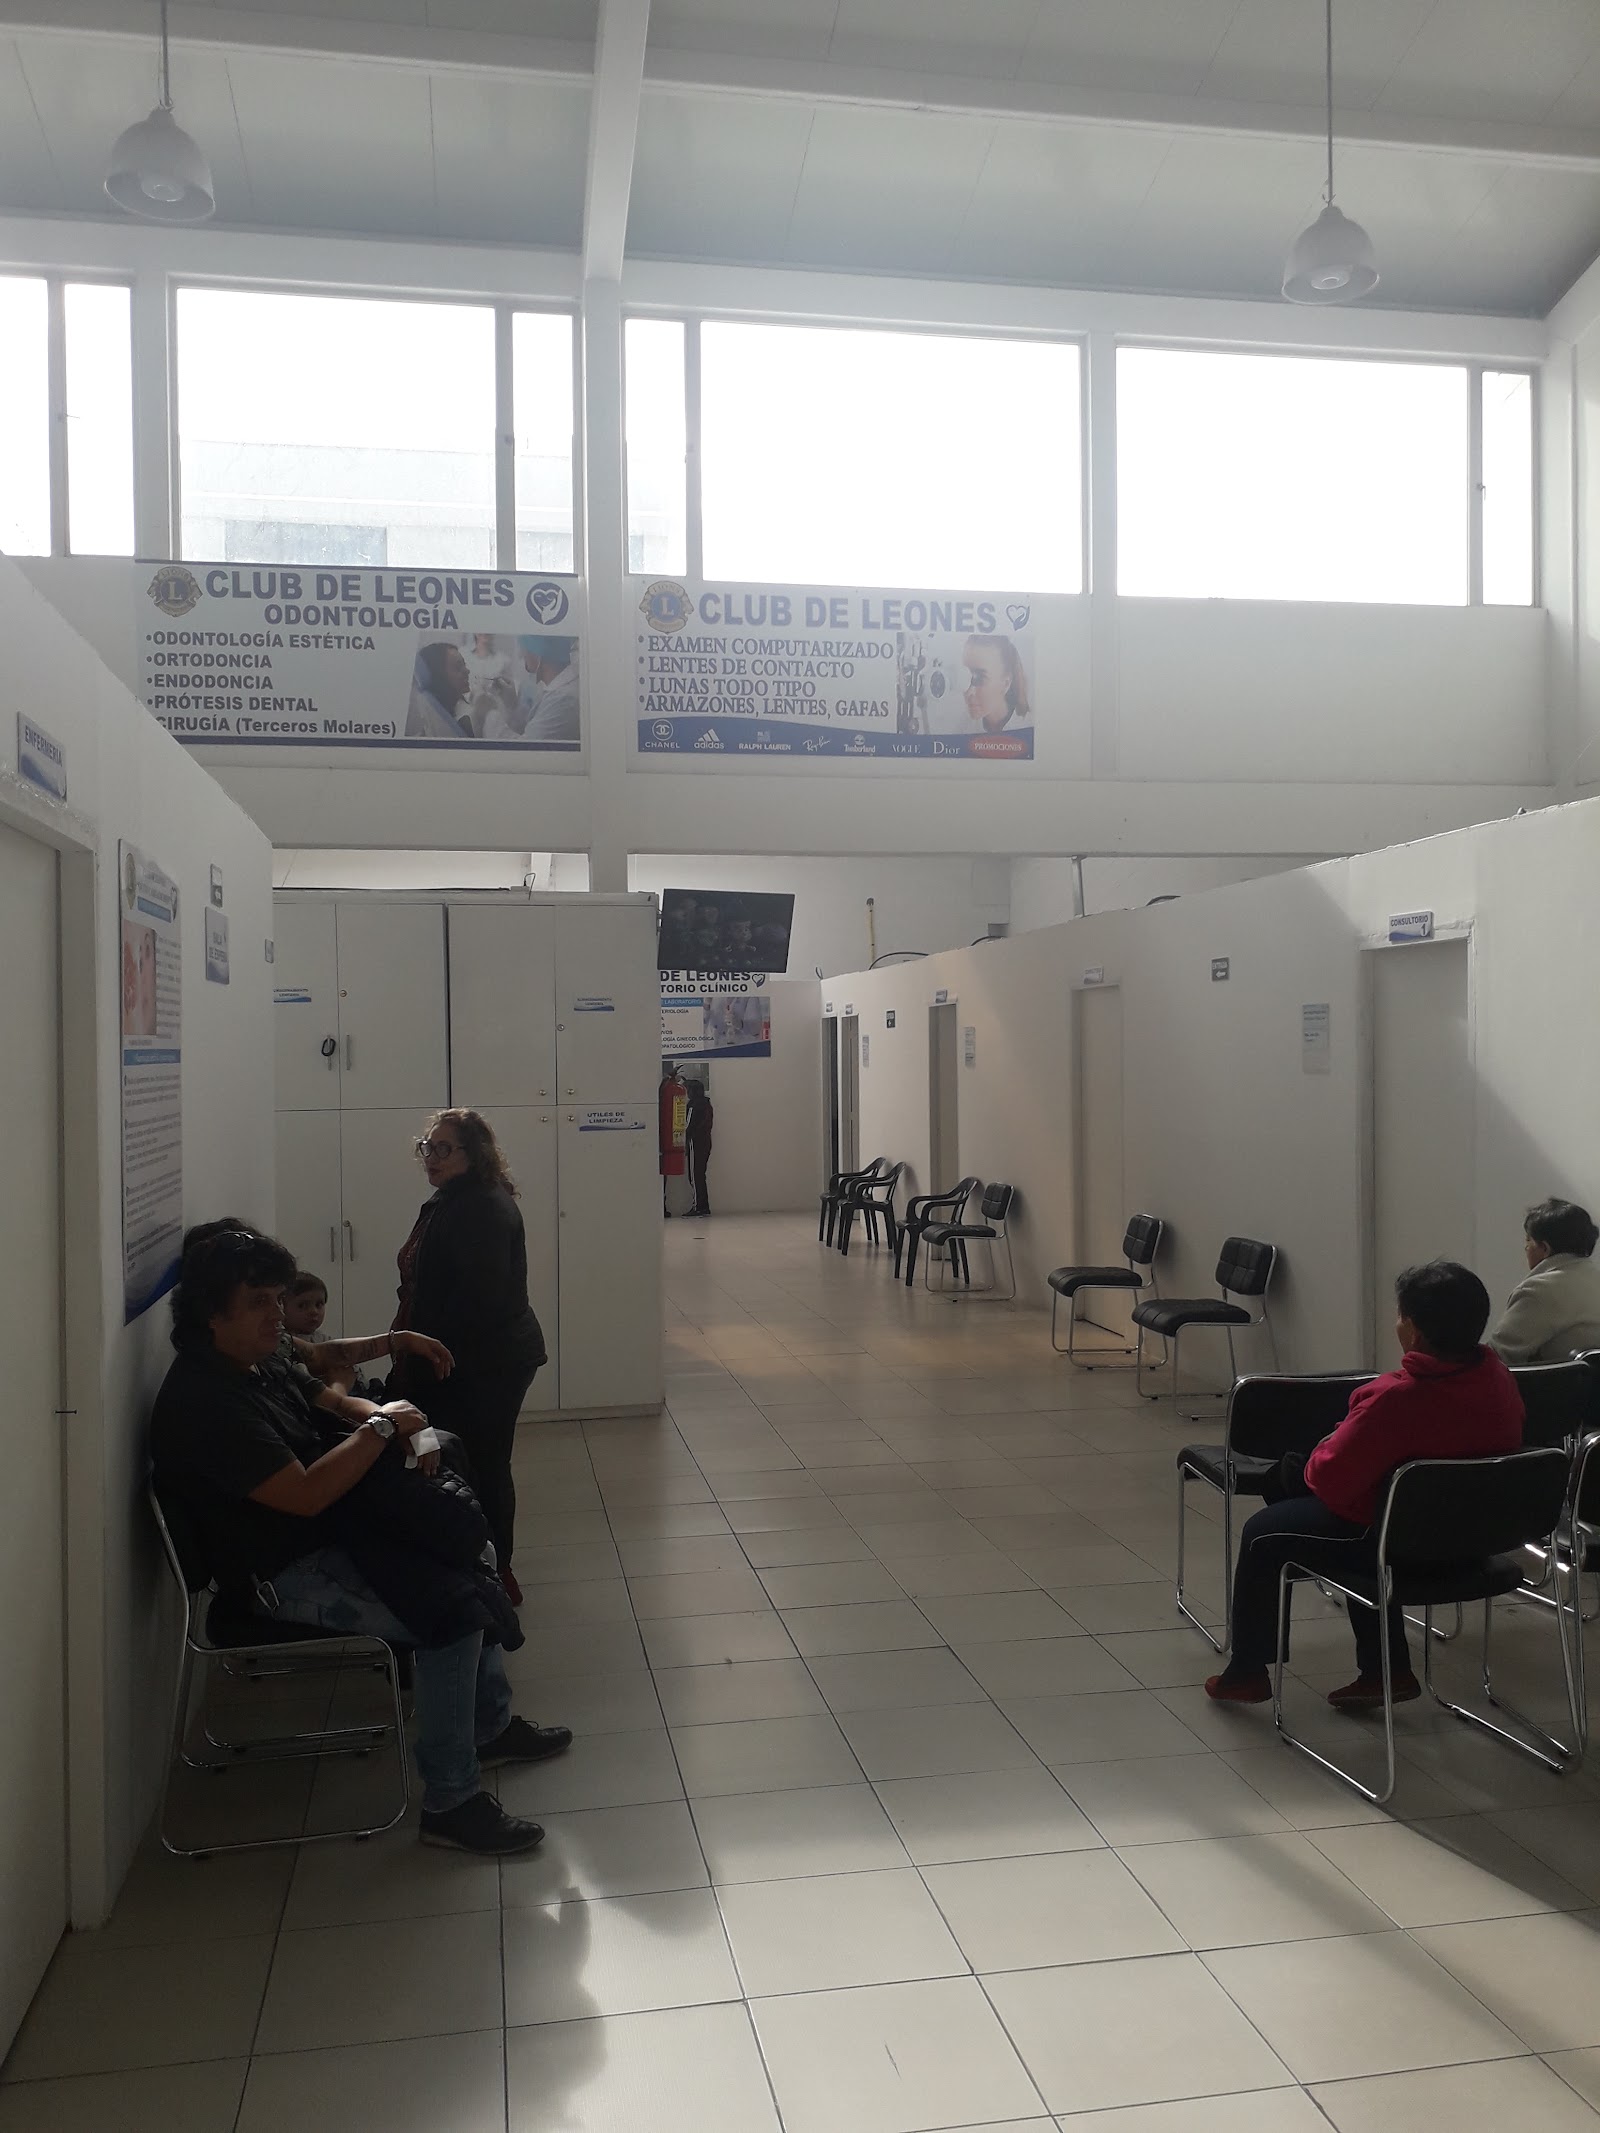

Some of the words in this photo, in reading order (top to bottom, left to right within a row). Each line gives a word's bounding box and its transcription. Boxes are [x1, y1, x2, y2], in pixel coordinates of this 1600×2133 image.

[205, 569, 303, 600] CLUB
[316, 573, 361, 603] DE
[375, 575, 515, 607] LEONES
[264, 604, 459, 630] ODONTOLOGÍA
[699, 592, 792, 626] CLUB
[806, 596, 848, 629] DE
[862, 598, 997, 633] LEONES
[153, 631, 284, 648] ODONTOLOGÍA
[289, 632, 375, 650] ESTÉTICA
[647, 636, 727, 655] EXAMEN
[731, 638, 894, 659] COMPUTARIZADO
[153, 652, 272, 669] ORTODONCIA
[648, 657, 717, 675] LENTES
[722, 659, 747, 675] DE
[750, 660, 854, 678] CONTACTO
[154, 674, 273, 690] ENDODONCIA
[649, 677, 708, 695] LUNAS
[713, 679, 767, 696] TODO
[772, 680, 816, 698] TIPO
[154, 693, 243, 711] PRÓTESIS
[249, 695, 318, 711] DENTAL
[644, 695, 759, 717] ARMAZONES,
[762, 698, 831, 720] LENTES,
[835, 700, 889, 717] GAFAS
[158, 714, 230, 732] CIRUGÍA
[235, 716, 318, 734] (Terceros
[323, 719, 397, 738] Molares)
[645, 741, 680, 749] CHANEL
[694, 740, 725, 750] adidas
[764, 743, 792, 751] LAUREN
[844, 743, 876, 753] Timberland
[933, 741, 961, 755] Dior
[974, 742, 1022, 752] PROMOCIONES
[1391, 915, 1429, 926] CONSULTORIO
[1421, 923, 1426, 935] 1
[661, 971, 681, 981] DE
[700, 982, 748, 993] CLÍNICO
